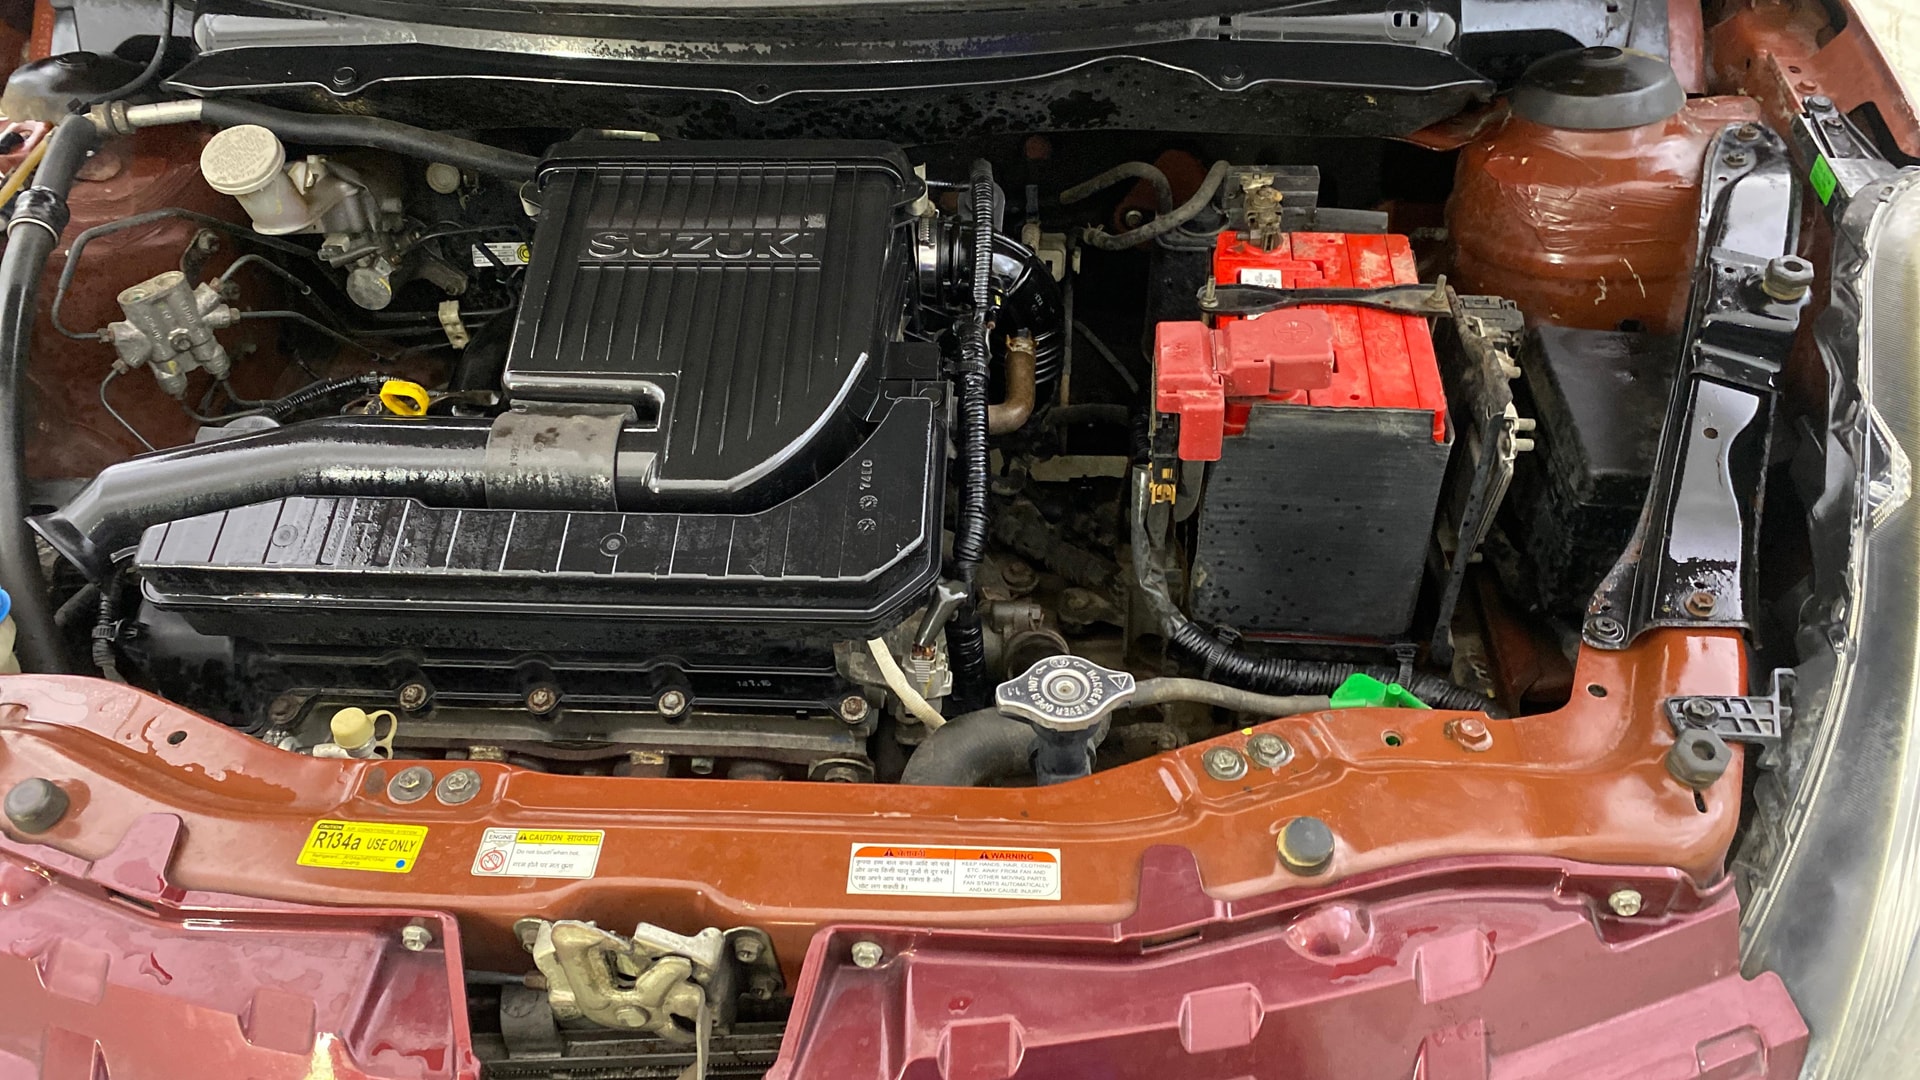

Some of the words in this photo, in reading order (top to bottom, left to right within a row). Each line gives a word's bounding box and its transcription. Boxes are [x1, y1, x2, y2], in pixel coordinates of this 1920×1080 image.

[588, 231, 816, 259] SUZUKI
[1028, 675, 1040, 692] HOT
[1030, 693, 1055, 713] OPEN
[1056, 703, 1090, 716] NEVER
[312, 831, 362, 850] R134a
[366, 838, 388, 851] USE
[389, 839, 417, 852] ONLY
[991, 852, 1034, 860] WARNING
